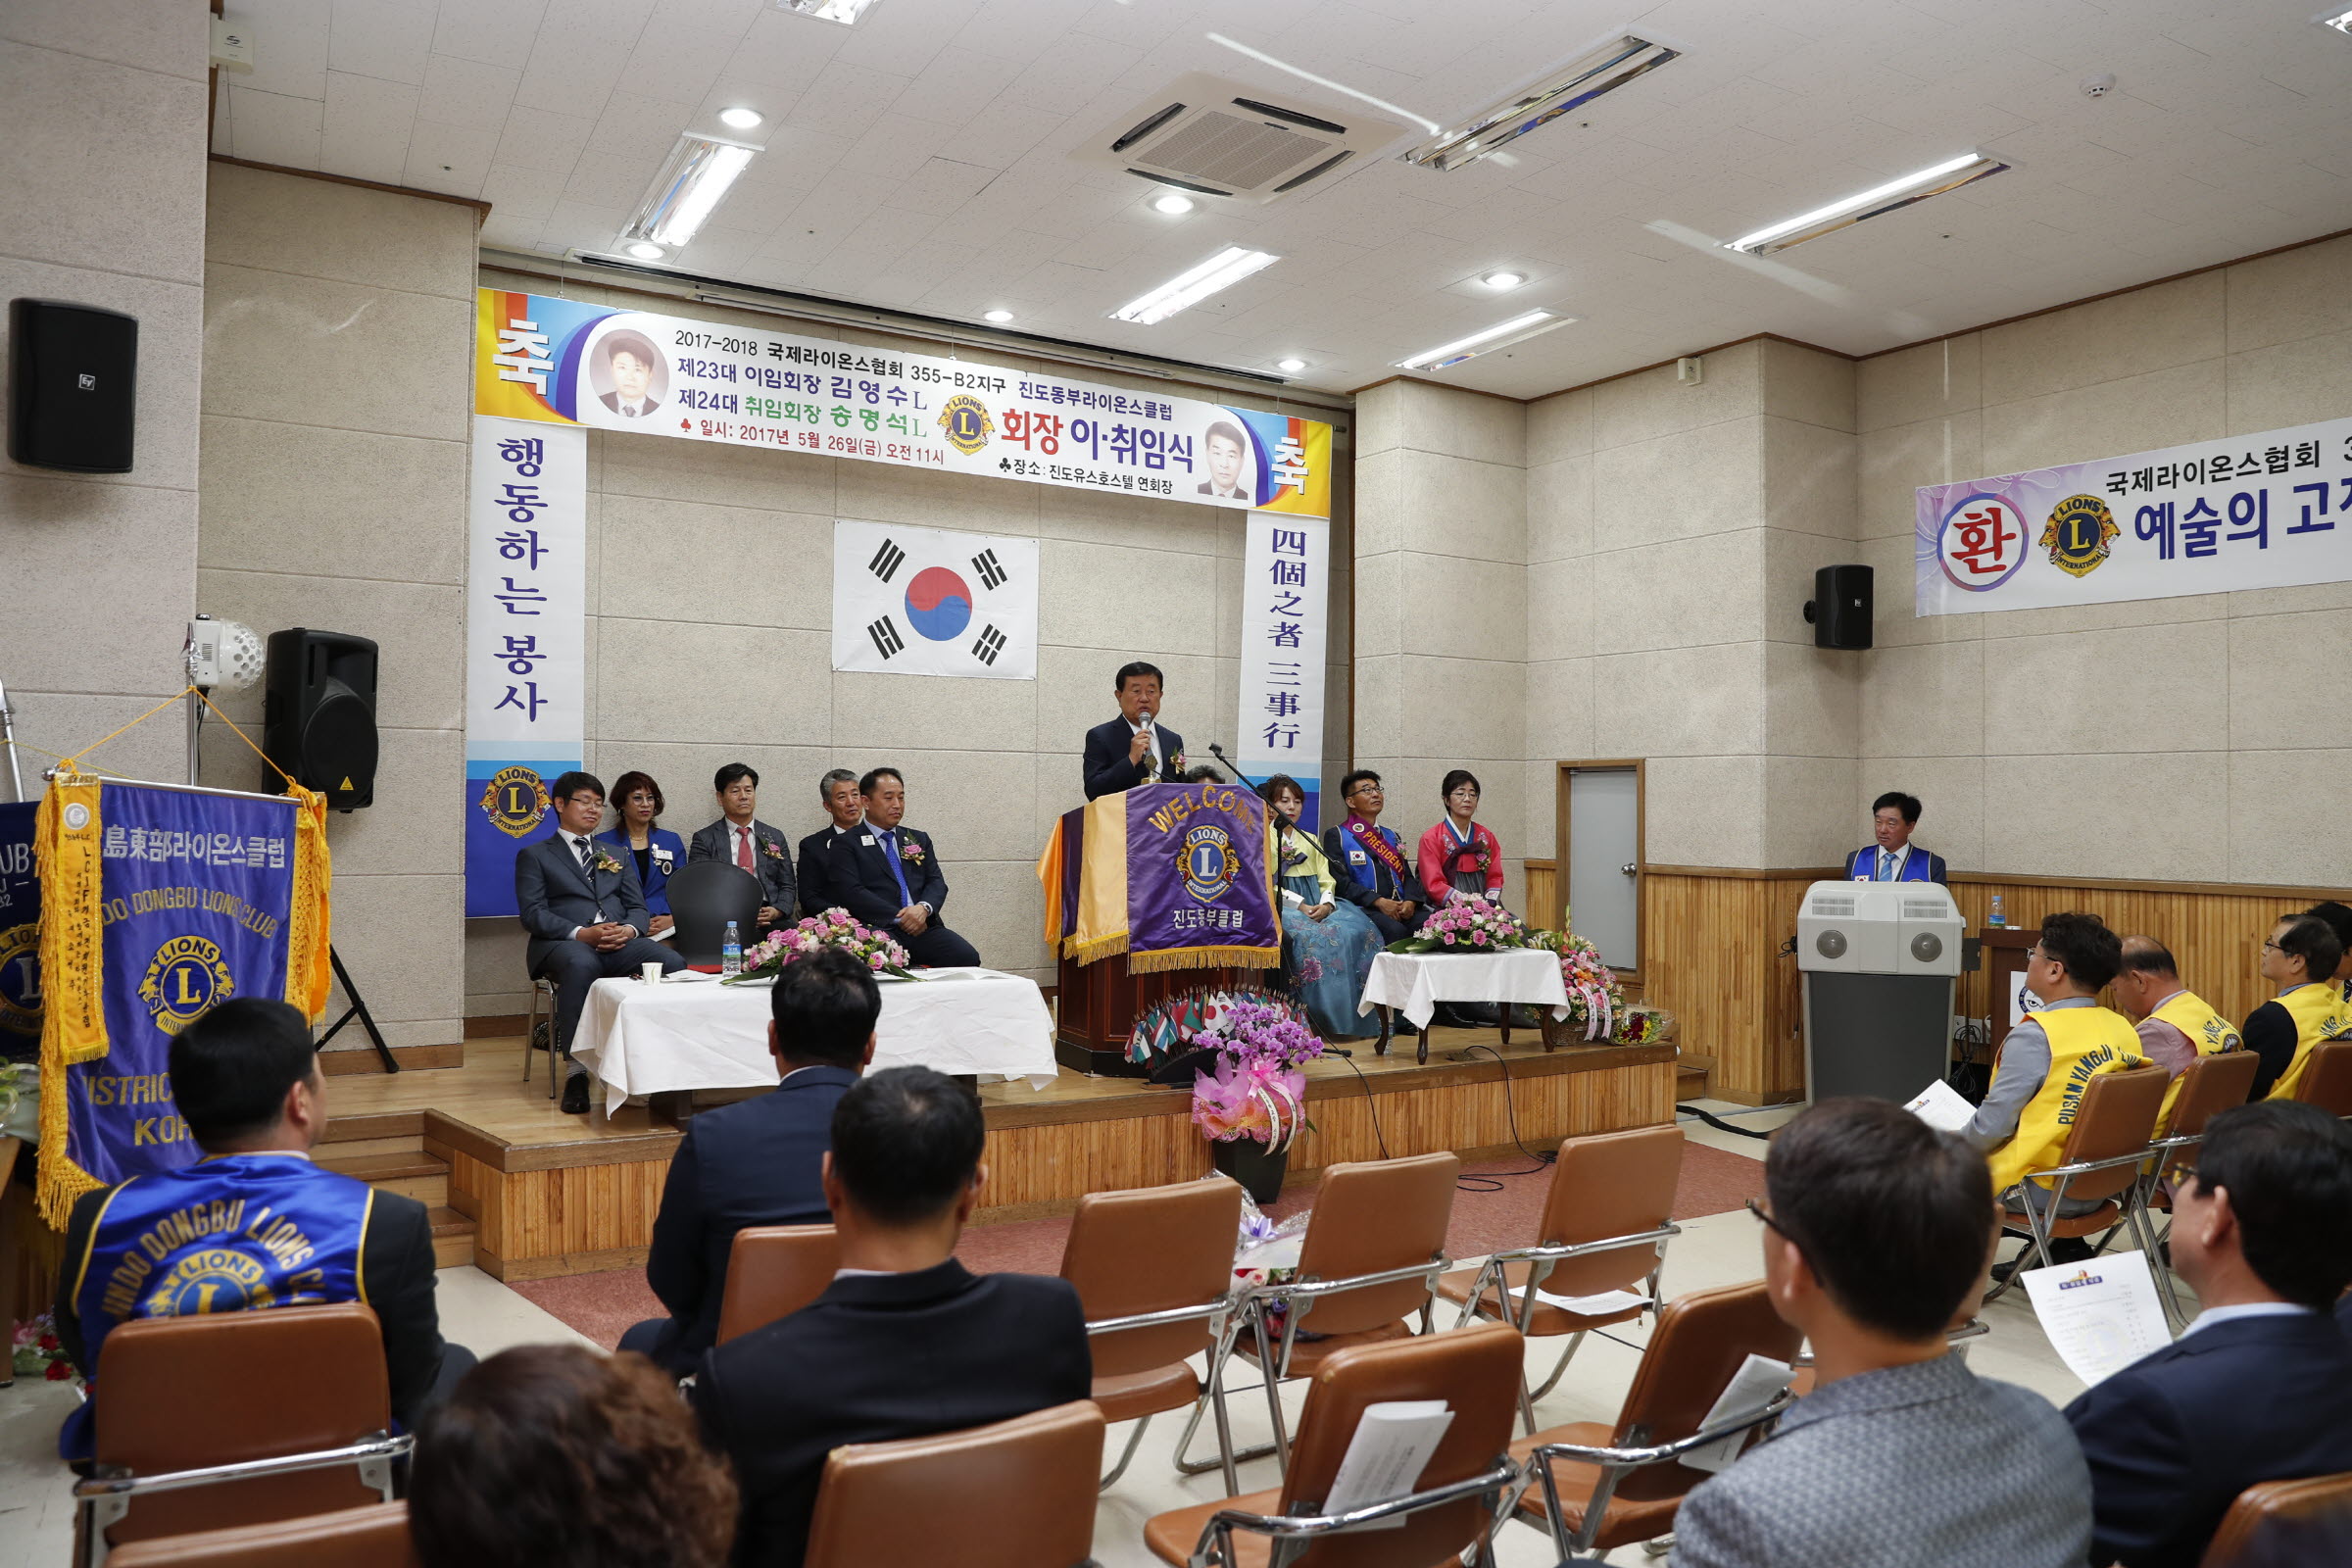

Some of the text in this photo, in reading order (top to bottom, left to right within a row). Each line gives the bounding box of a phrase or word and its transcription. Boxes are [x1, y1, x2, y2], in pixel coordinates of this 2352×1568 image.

[493, 318, 555, 396] 축
[675, 330, 1173, 421] 2017-2018 국제라이온스협회 355-B2지구 진도동부라이온스클럽
[677, 358, 737, 383] 제23대
[745, 367, 821, 394] 이임회장
[678, 389, 738, 415] 제24대
[745, 396, 821, 424] 취임회장
[952, 397, 983, 412] LIONS
[700, 419, 944, 465] 일시: 2017년 5월 26일(금) 오전 11시
[959, 412, 975, 436] L
[1002, 408, 1063, 456] 회장
[1050, 465, 1133, 490] 진도유스호스텔
[1138, 476, 1173, 495] 연회장
[1271, 436, 1308, 495] 축
[2106, 440, 2320, 496] 국제라이온스협회
[2058, 498, 2101, 516] LIONS
[2134, 488, 2268, 561] 예술의
[1949, 507, 2017, 574] 환
[2069, 519, 2090, 550] L
[494, 437, 549, 722] 행동하는 봉사
[498, 768, 537, 784] LIONS
[508, 787, 527, 813] L
[1148, 785, 1255, 834] WELCOME
[103, 824, 285, 868] 島東部라이온스클럽
[1190, 828, 1227, 846] LIONS
[1363, 831, 1403, 873] PRESIDENT
[1199, 847, 1217, 877] L
[101, 887, 279, 939] DO DONGBU LIONS CLUB
[1173, 908, 1244, 929] 진도동부클럽
[161, 938, 217, 962] LIONS
[175, 967, 202, 1004] L
[83, 1072, 174, 1105] ISTRIC
[2058, 1044, 2114, 1125] PUSAN YANGJI
[139, 1199, 245, 1262] DONGBU
[246, 1206, 315, 1270] LIONS
[184, 1252, 256, 1281] LIONS
